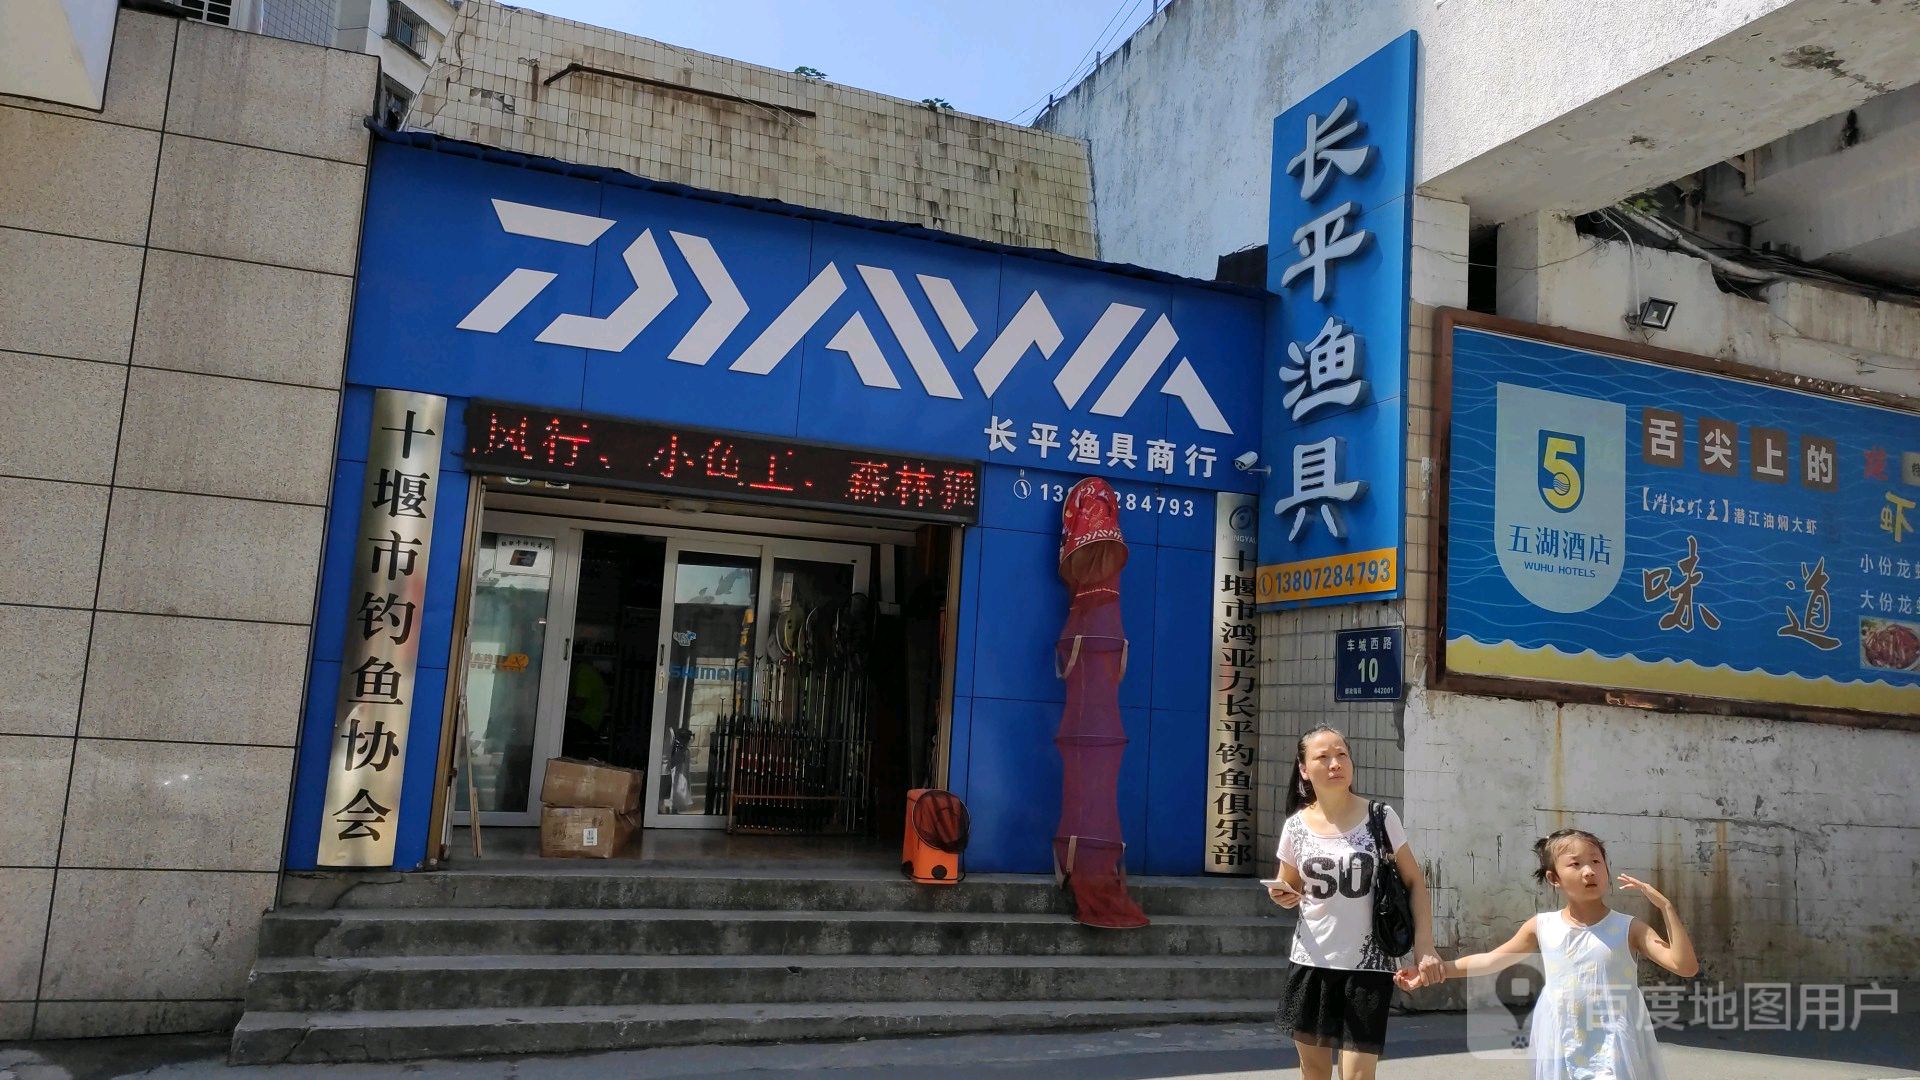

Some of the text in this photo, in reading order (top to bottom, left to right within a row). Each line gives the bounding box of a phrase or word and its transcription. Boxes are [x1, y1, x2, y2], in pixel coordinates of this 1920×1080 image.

[1275, 97, 1372, 541] 长平渔具
[984, 416, 1217, 478] 长平渔具商行
[1648, 418, 1834, 484] 舌尖上的
[1040, 483, 1194, 517] 13284793
[1508, 524, 1613, 566] 五湖酒店
[1524, 561, 1596, 579] WUHU HOTELS
[1276, 558, 1391, 593] 13807284793
[1642, 535, 1842, 651] 味道
[332, 410, 436, 843] 十堰市钓鱼协会
[1347, 636, 1392, 652] 车城西路
[1358, 657, 1379, 683] 10
[1211, 550, 1257, 866] 十堰市鸿亚力长平钓鱼俱乐部
